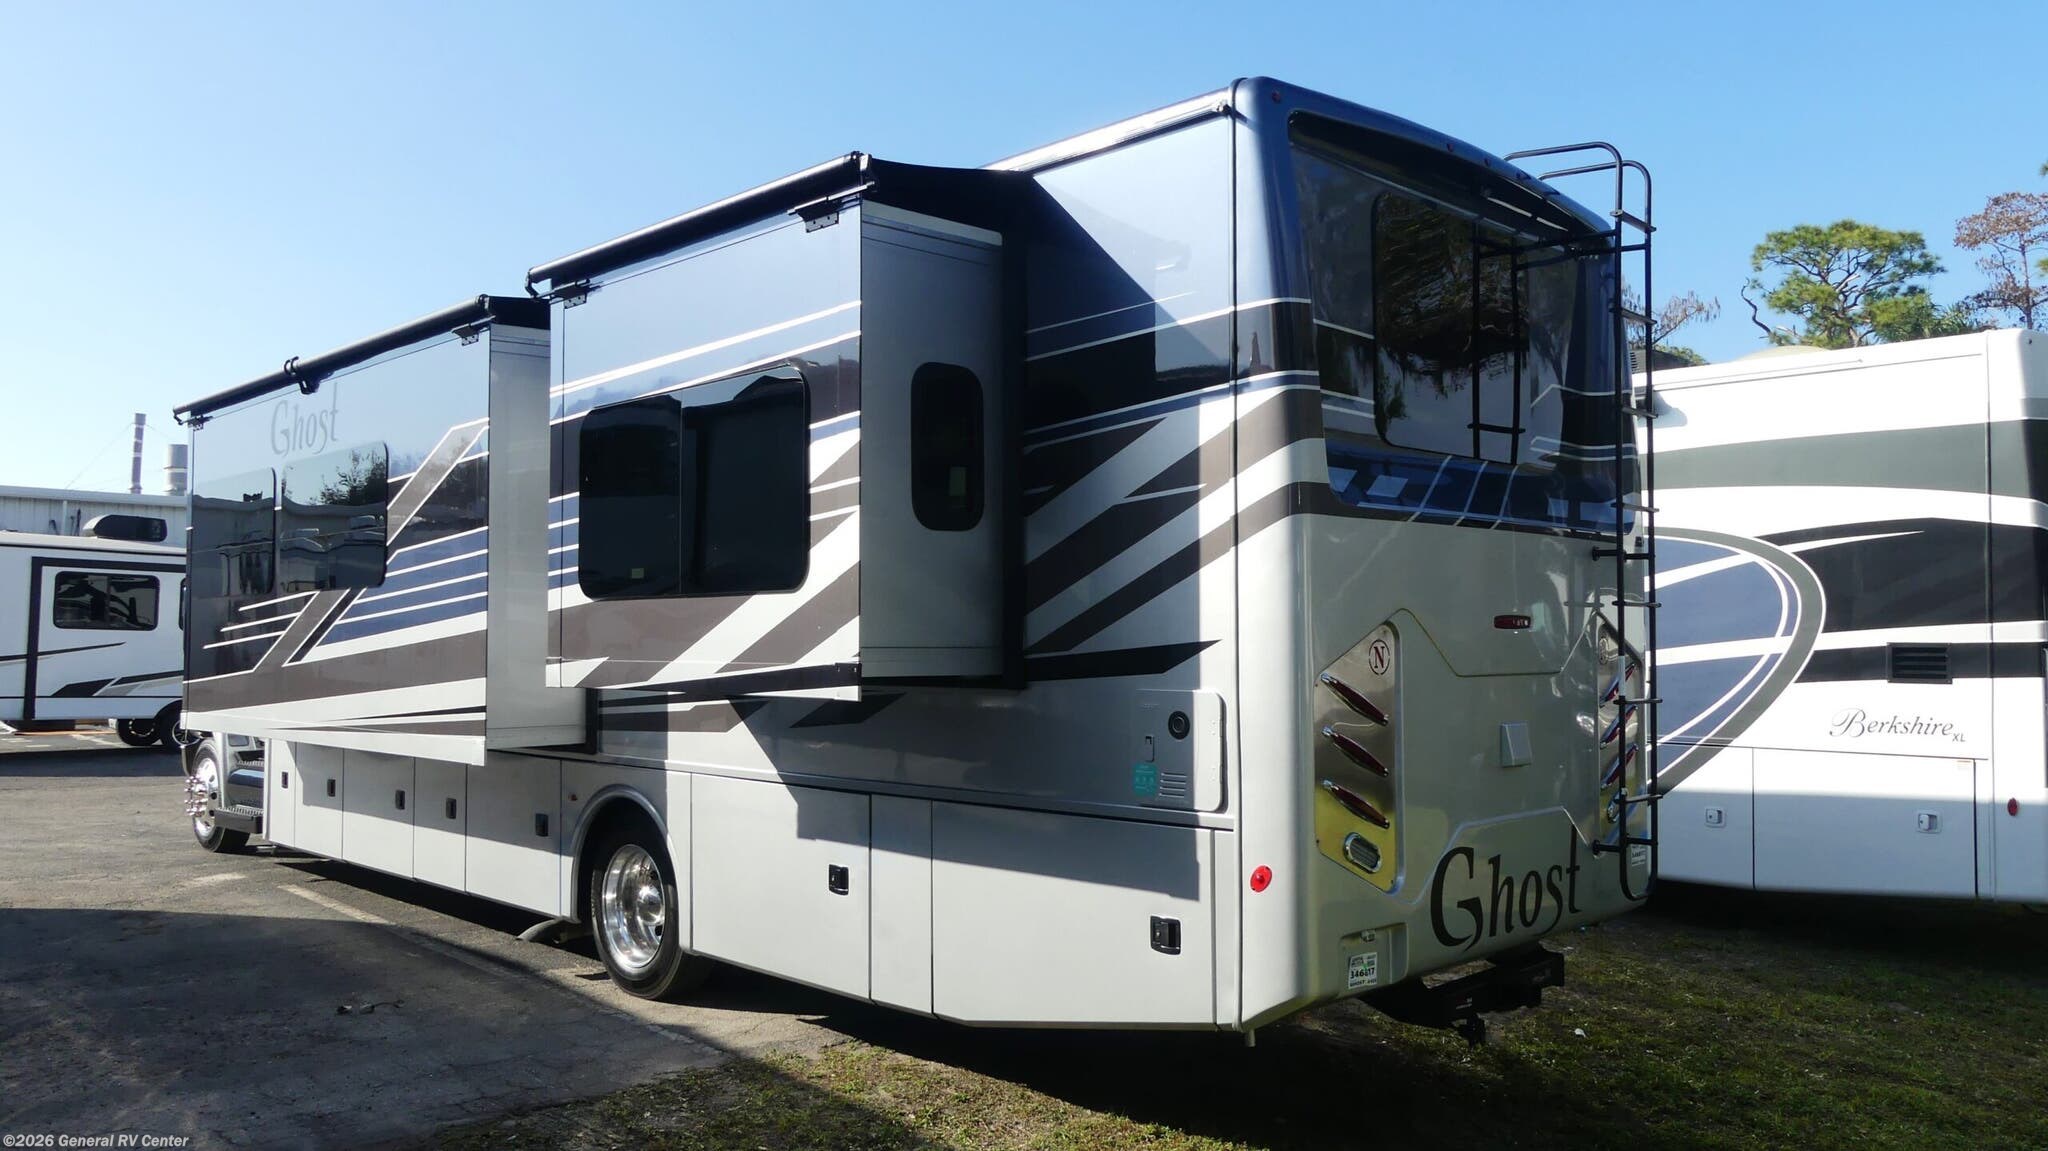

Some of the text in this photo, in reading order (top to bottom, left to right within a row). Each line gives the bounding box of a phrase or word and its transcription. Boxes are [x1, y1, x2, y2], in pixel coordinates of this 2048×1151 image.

[271, 381, 339, 458] Ghost
[1829, 707, 1966, 743] Berkshire XL
[1430, 824, 1582, 952] Ghost
